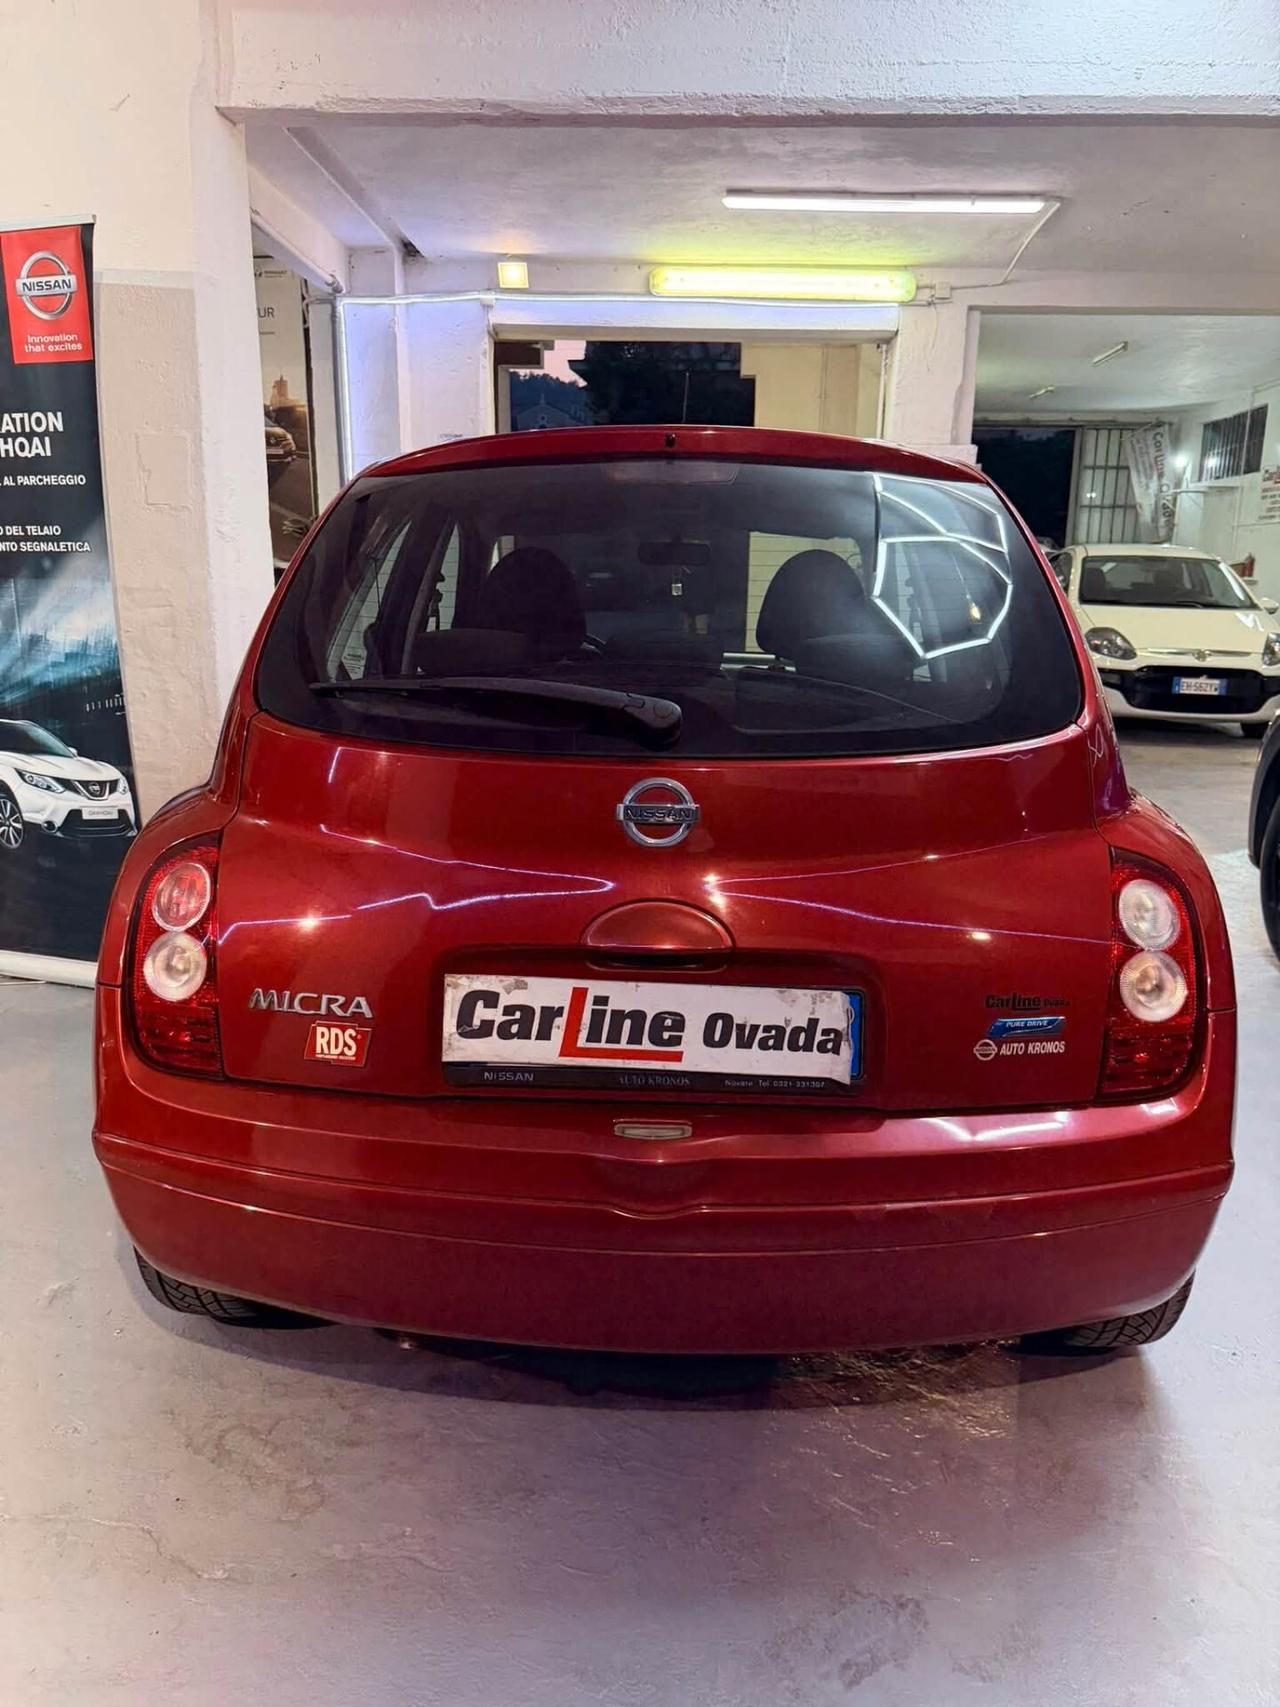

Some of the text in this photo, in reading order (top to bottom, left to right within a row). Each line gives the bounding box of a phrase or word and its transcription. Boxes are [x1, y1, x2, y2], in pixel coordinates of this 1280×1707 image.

[22, 279, 72, 292] NISSAN
[27, 333, 78, 343] Innovation
[25, 343, 82, 352] that excites
[0, 411, 64, 433] ATION
[3, 475, 16, 486] AL
[17, 474, 87, 486] PARCHEGGIO
[5, 525, 25, 536] DEL
[26, 525, 62, 536] TELAIO
[20, 541, 91, 552] SEGNALETICA
[625, 807, 693, 820] NISSAN
[249, 987, 374, 1018] MICRA
[457, 986, 843, 1062] CarLine Ovada
[315, 1026, 357, 1056] RDS
[1000, 1042, 1025, 1056] AUTO
[1027, 1041, 1066, 1055] KRONOS
[484, 1071, 534, 1081] NISSAN
[619, 1074, 690, 1087] AUTO KRONOS
